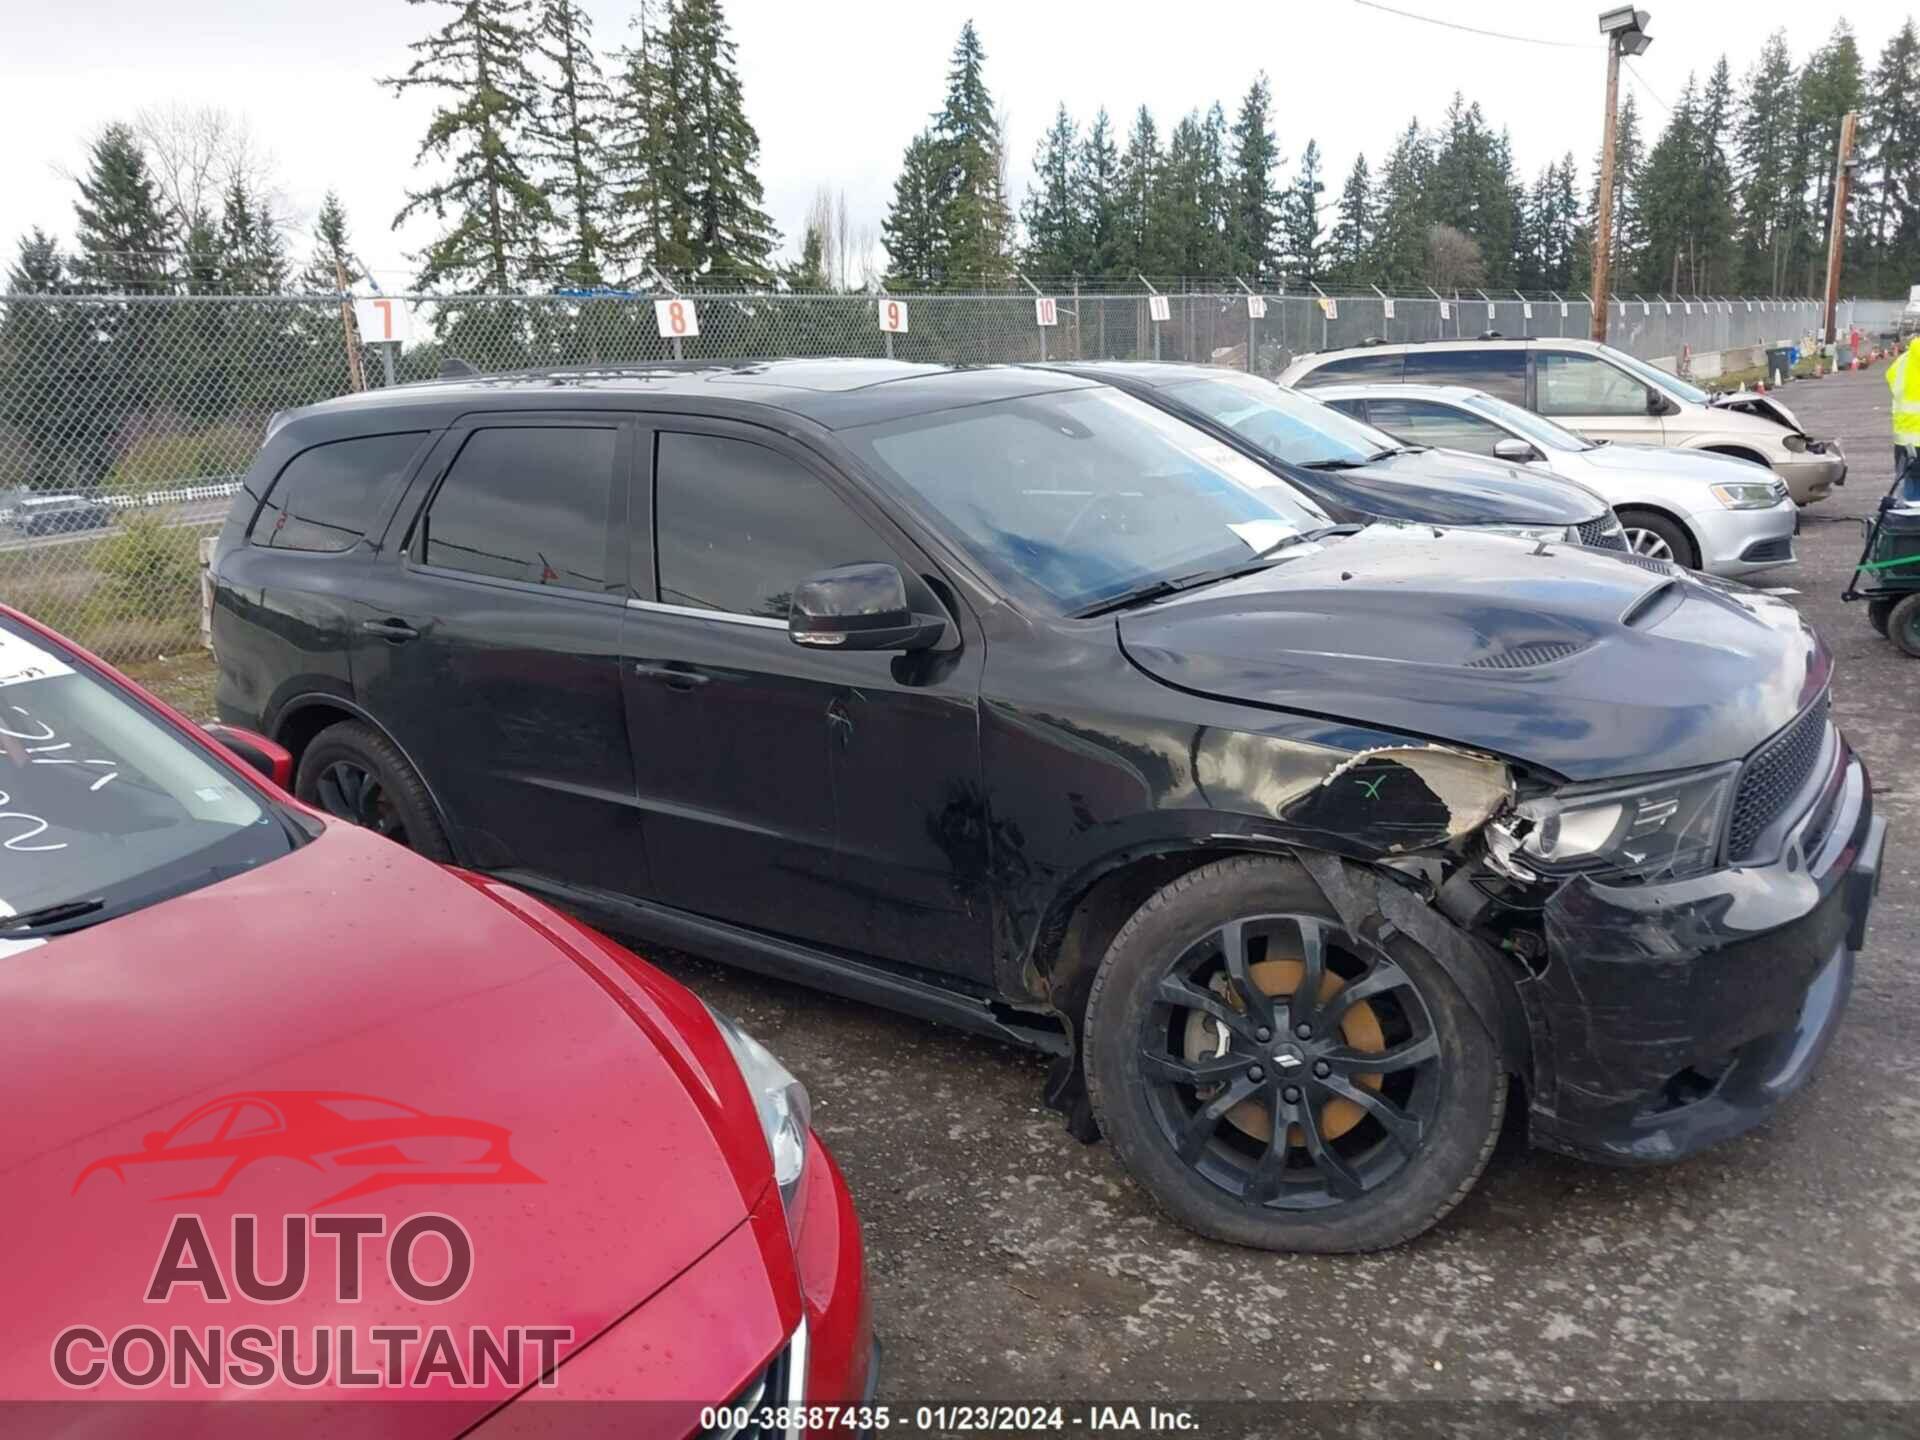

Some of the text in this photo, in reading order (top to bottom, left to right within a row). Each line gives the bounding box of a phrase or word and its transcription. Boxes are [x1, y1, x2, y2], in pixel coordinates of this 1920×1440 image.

[374, 300, 392, 340] 7
[668, 301, 686, 335] 8
[887, 302, 899, 330] 9
[1039, 300, 1054, 323] 10
